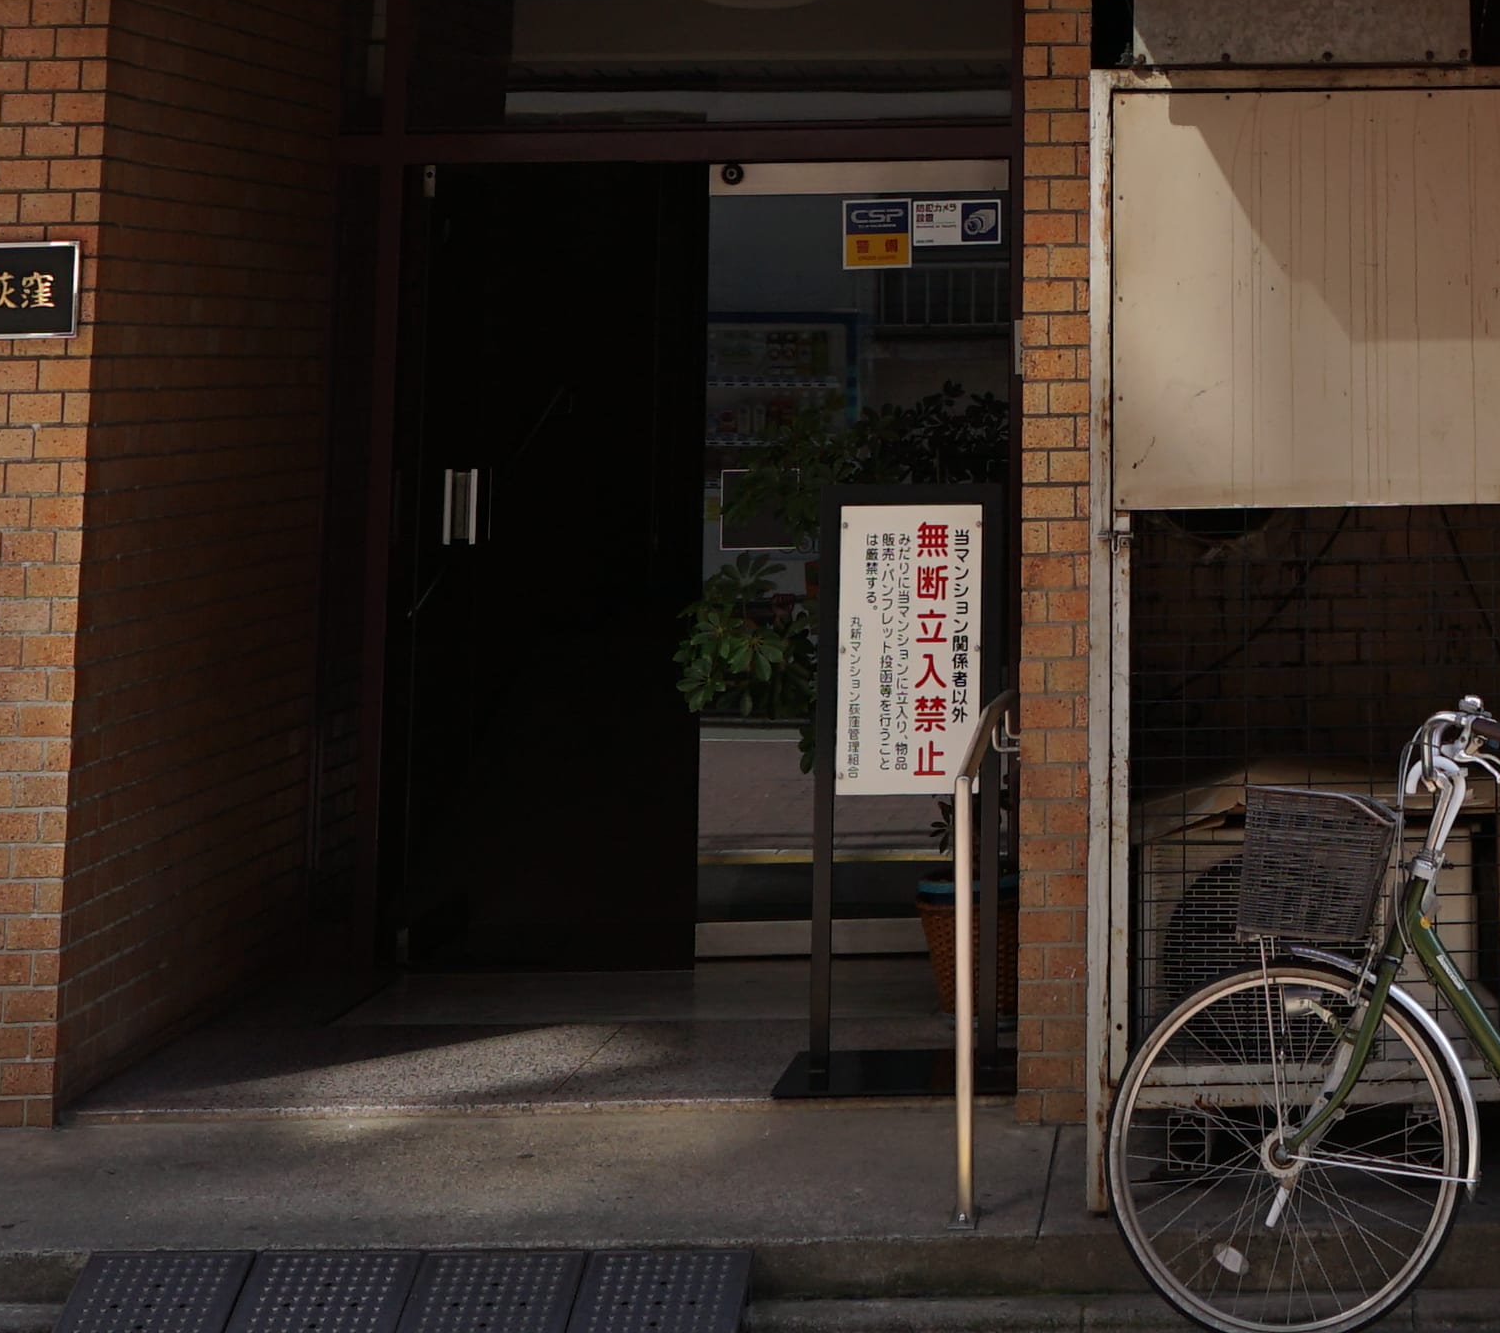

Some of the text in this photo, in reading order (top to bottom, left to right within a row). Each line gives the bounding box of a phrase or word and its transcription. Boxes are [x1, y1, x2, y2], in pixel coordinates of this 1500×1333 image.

[851, 208, 904, 224] CSP
[916, 203, 957, 213] 防犯カメラ
[913, 521, 949, 777] 無断立入禁止
[951, 528, 970, 724] 当マンション関係者以外
